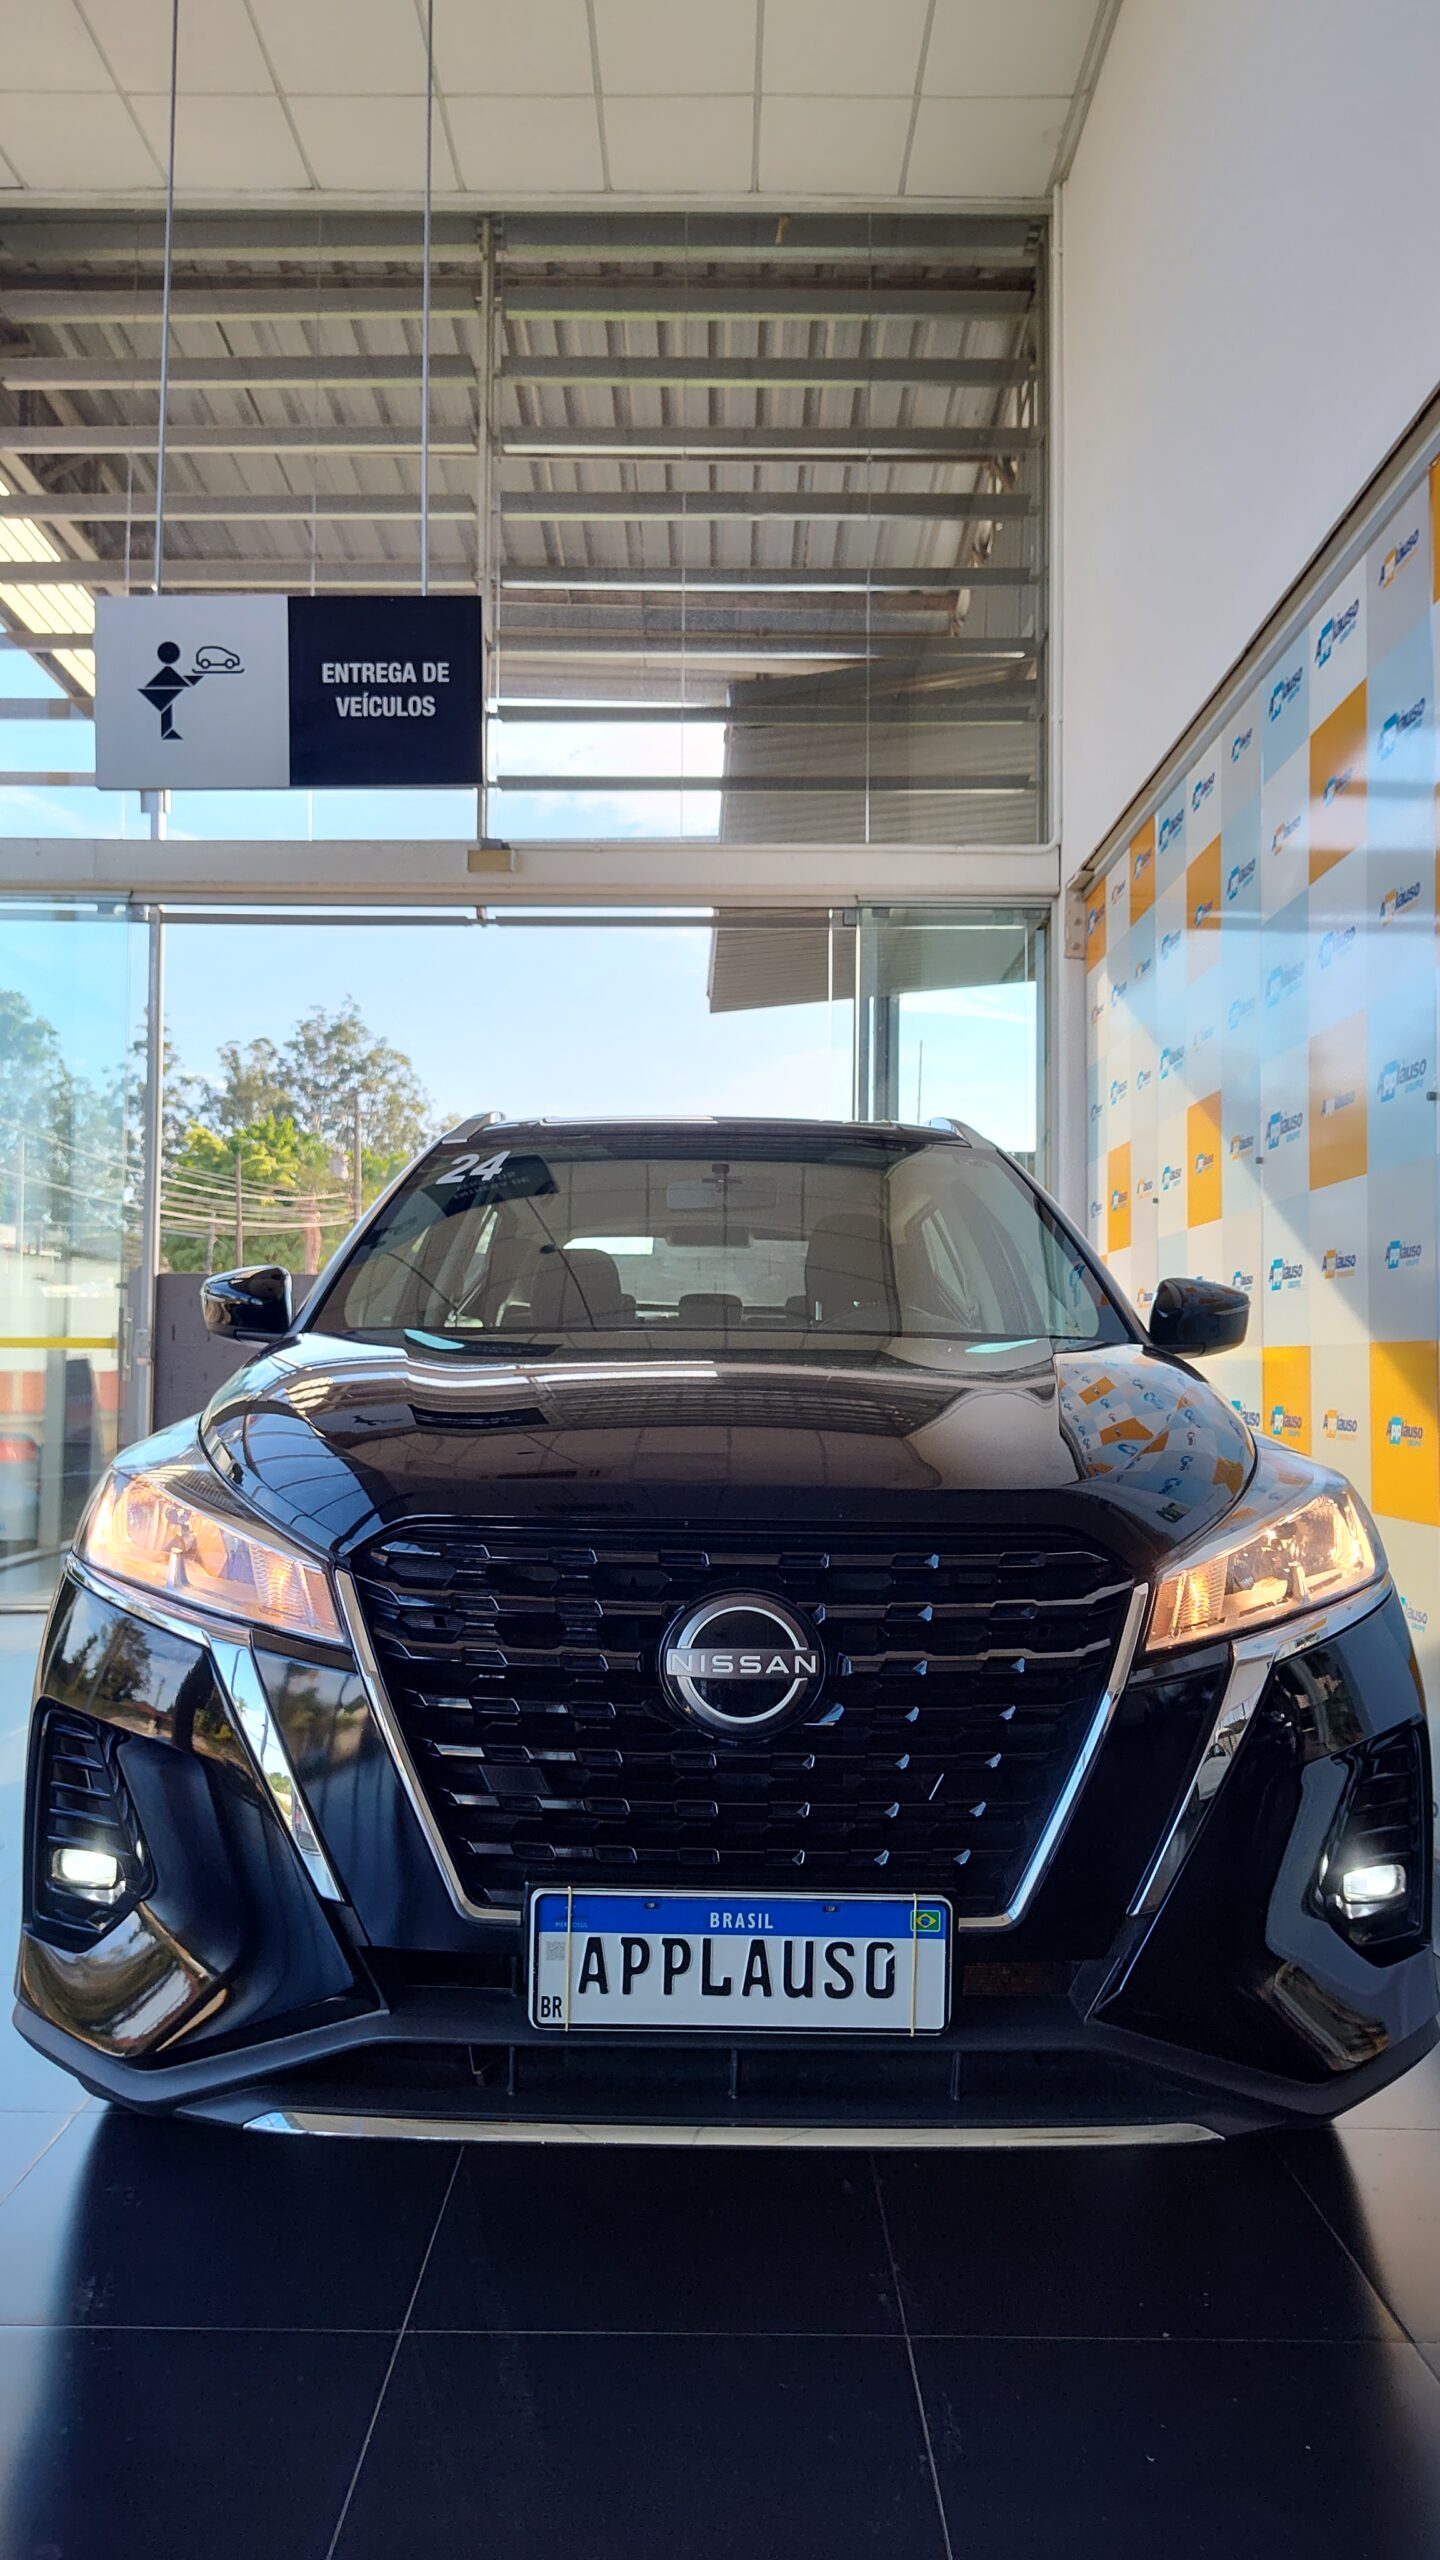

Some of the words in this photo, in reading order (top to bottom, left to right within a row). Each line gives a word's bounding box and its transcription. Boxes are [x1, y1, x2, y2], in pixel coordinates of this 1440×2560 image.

[321, 661, 417, 685] ENTREGA
[422, 661, 451, 684] DE
[335, 691, 437, 718] VEÍCULOS
[435, 1150, 512, 1185] 24
[671, 1654, 816, 1674] NISSAN
[555, 1921, 588, 1929] MEROSUL
[709, 1911, 774, 1930] BRASIL
[540, 1995, 563, 2018] BR
